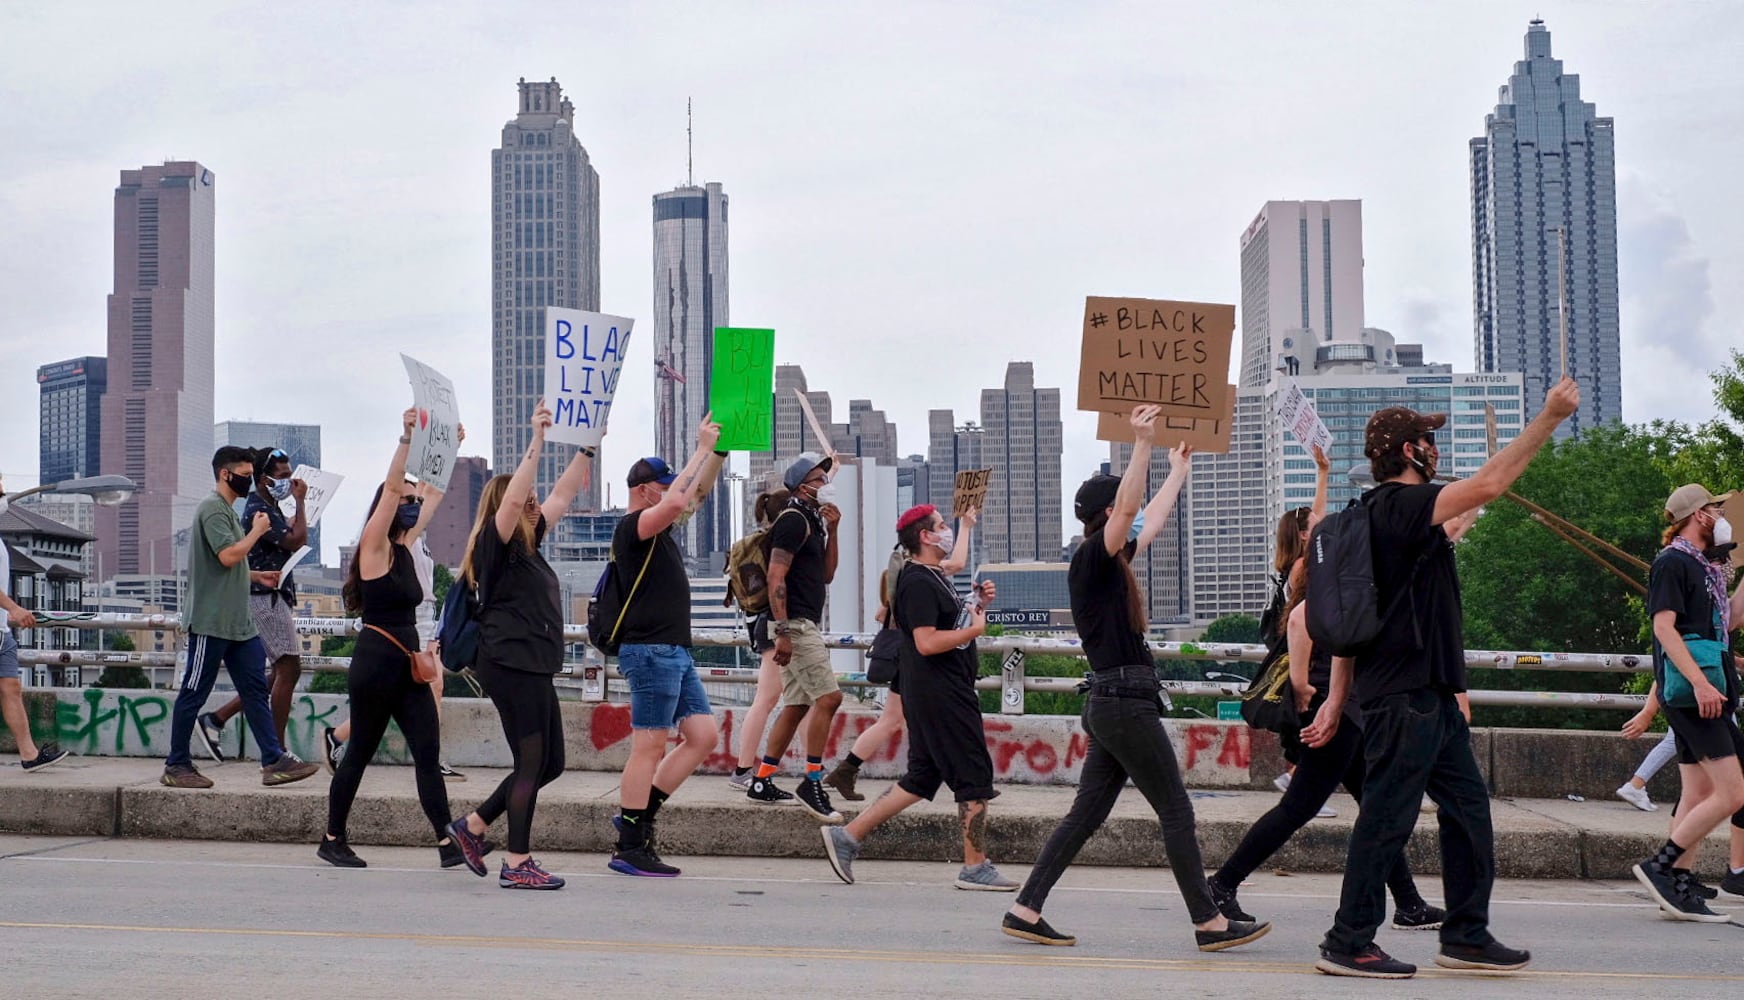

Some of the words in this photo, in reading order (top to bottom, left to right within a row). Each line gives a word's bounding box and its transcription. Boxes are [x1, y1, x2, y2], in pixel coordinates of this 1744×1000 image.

[1118, 339, 1208, 363] LIVES
[1099, 370, 1210, 404] MATTER
[1464, 375, 1508, 383] ALTITUDE
[986, 613, 1026, 622] CRISTO
[1028, 613, 1048, 622] REY
